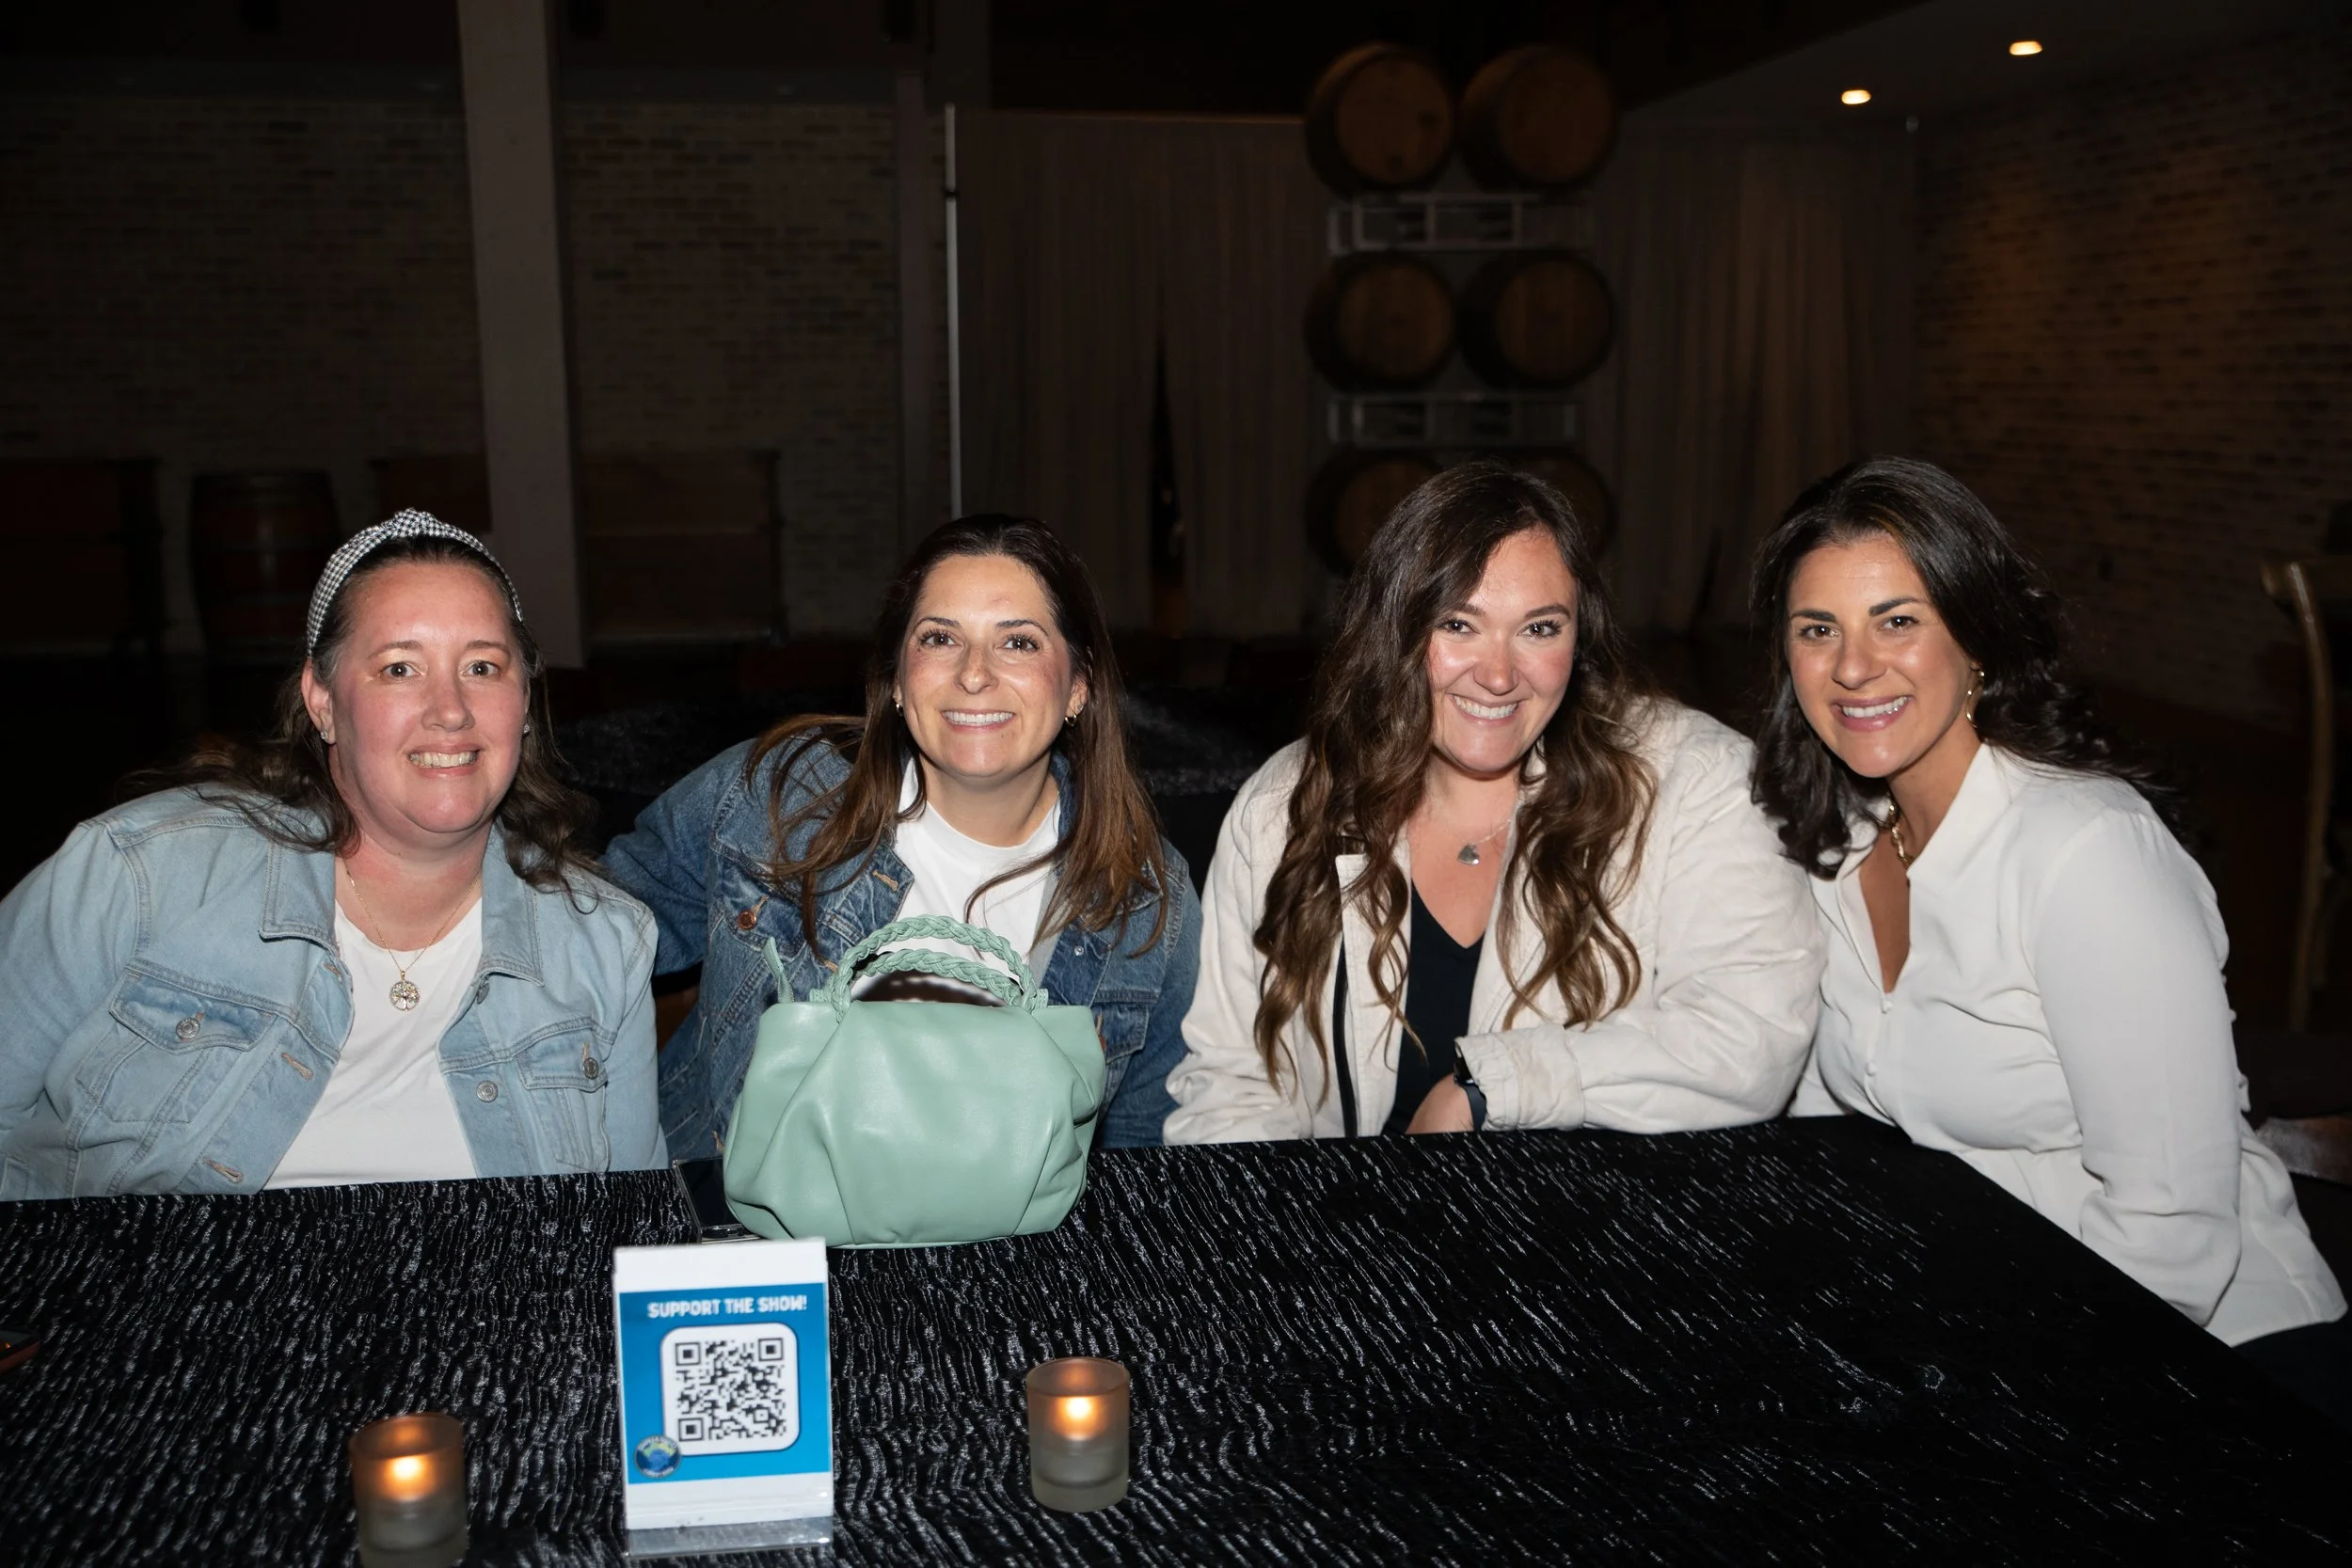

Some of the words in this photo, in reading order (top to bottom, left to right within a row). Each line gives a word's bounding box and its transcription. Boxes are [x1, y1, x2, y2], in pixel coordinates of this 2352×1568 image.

[647, 1299, 721, 1318] SUPPORT
[724, 1297, 754, 1314] THE
[757, 1294, 807, 1312] SHOW!
